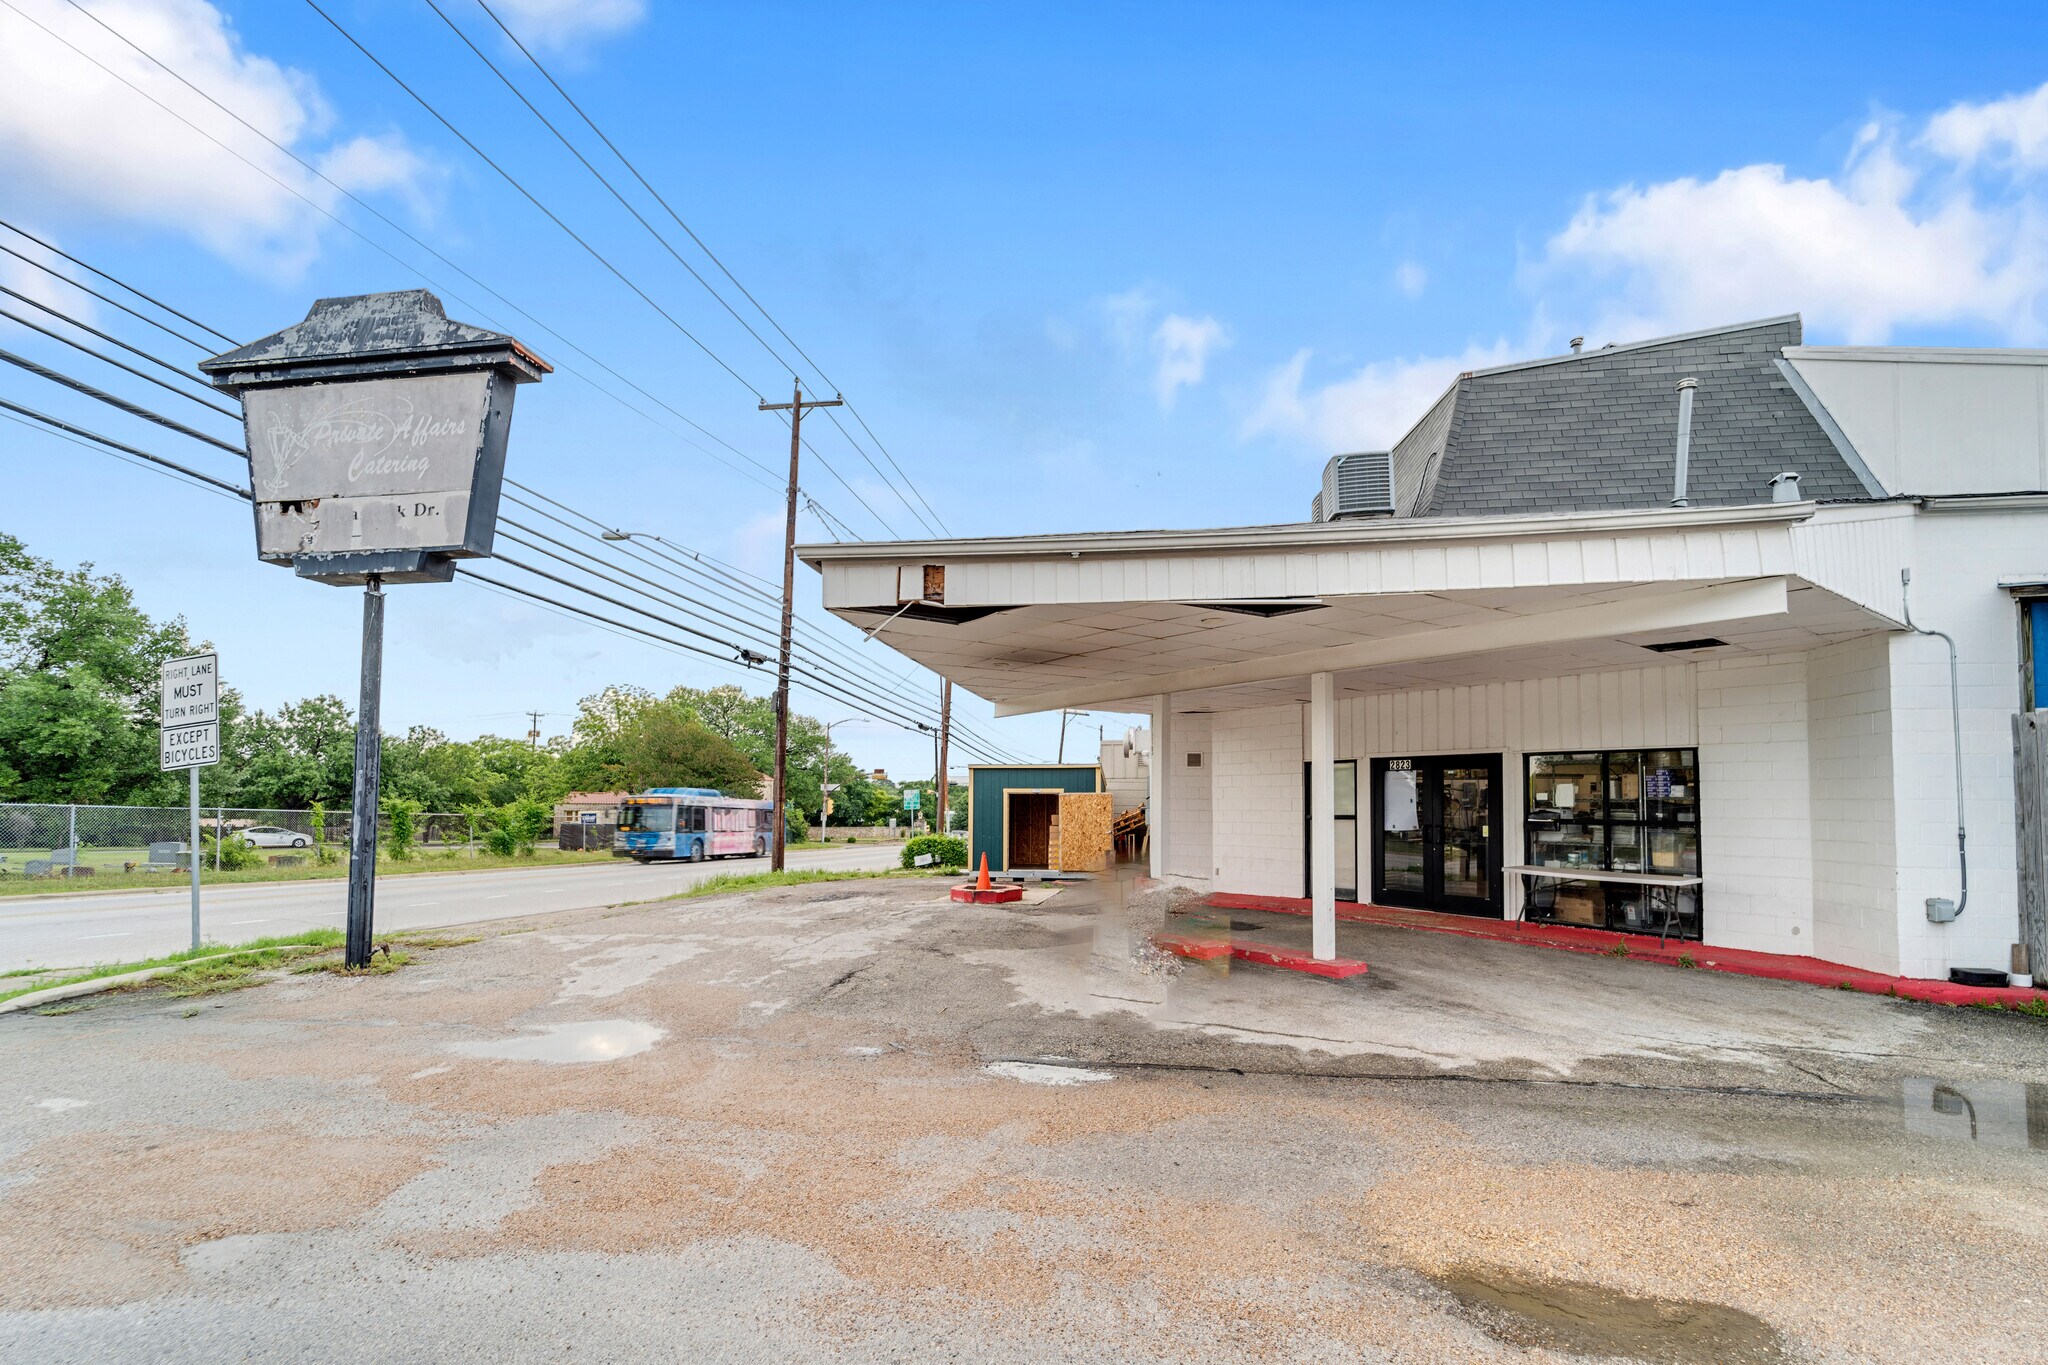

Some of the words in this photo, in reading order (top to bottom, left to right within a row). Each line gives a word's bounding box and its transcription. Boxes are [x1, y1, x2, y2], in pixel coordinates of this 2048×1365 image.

[314, 420, 384, 447] Private
[396, 414, 467, 447] Affairs
[347, 448, 430, 482] Catering
[414, 502, 440, 517] Dr.
[165, 667, 189, 680] RIGHT
[191, 663, 213, 676] LANE
[173, 683, 203, 700] MUST
[165, 705, 186, 720] TURN
[189, 702, 214, 716] RIGHT
[169, 728, 209, 746] EXCEPT
[164, 745, 215, 764] BICYCLES
[1390, 760, 1411, 770] 2823
